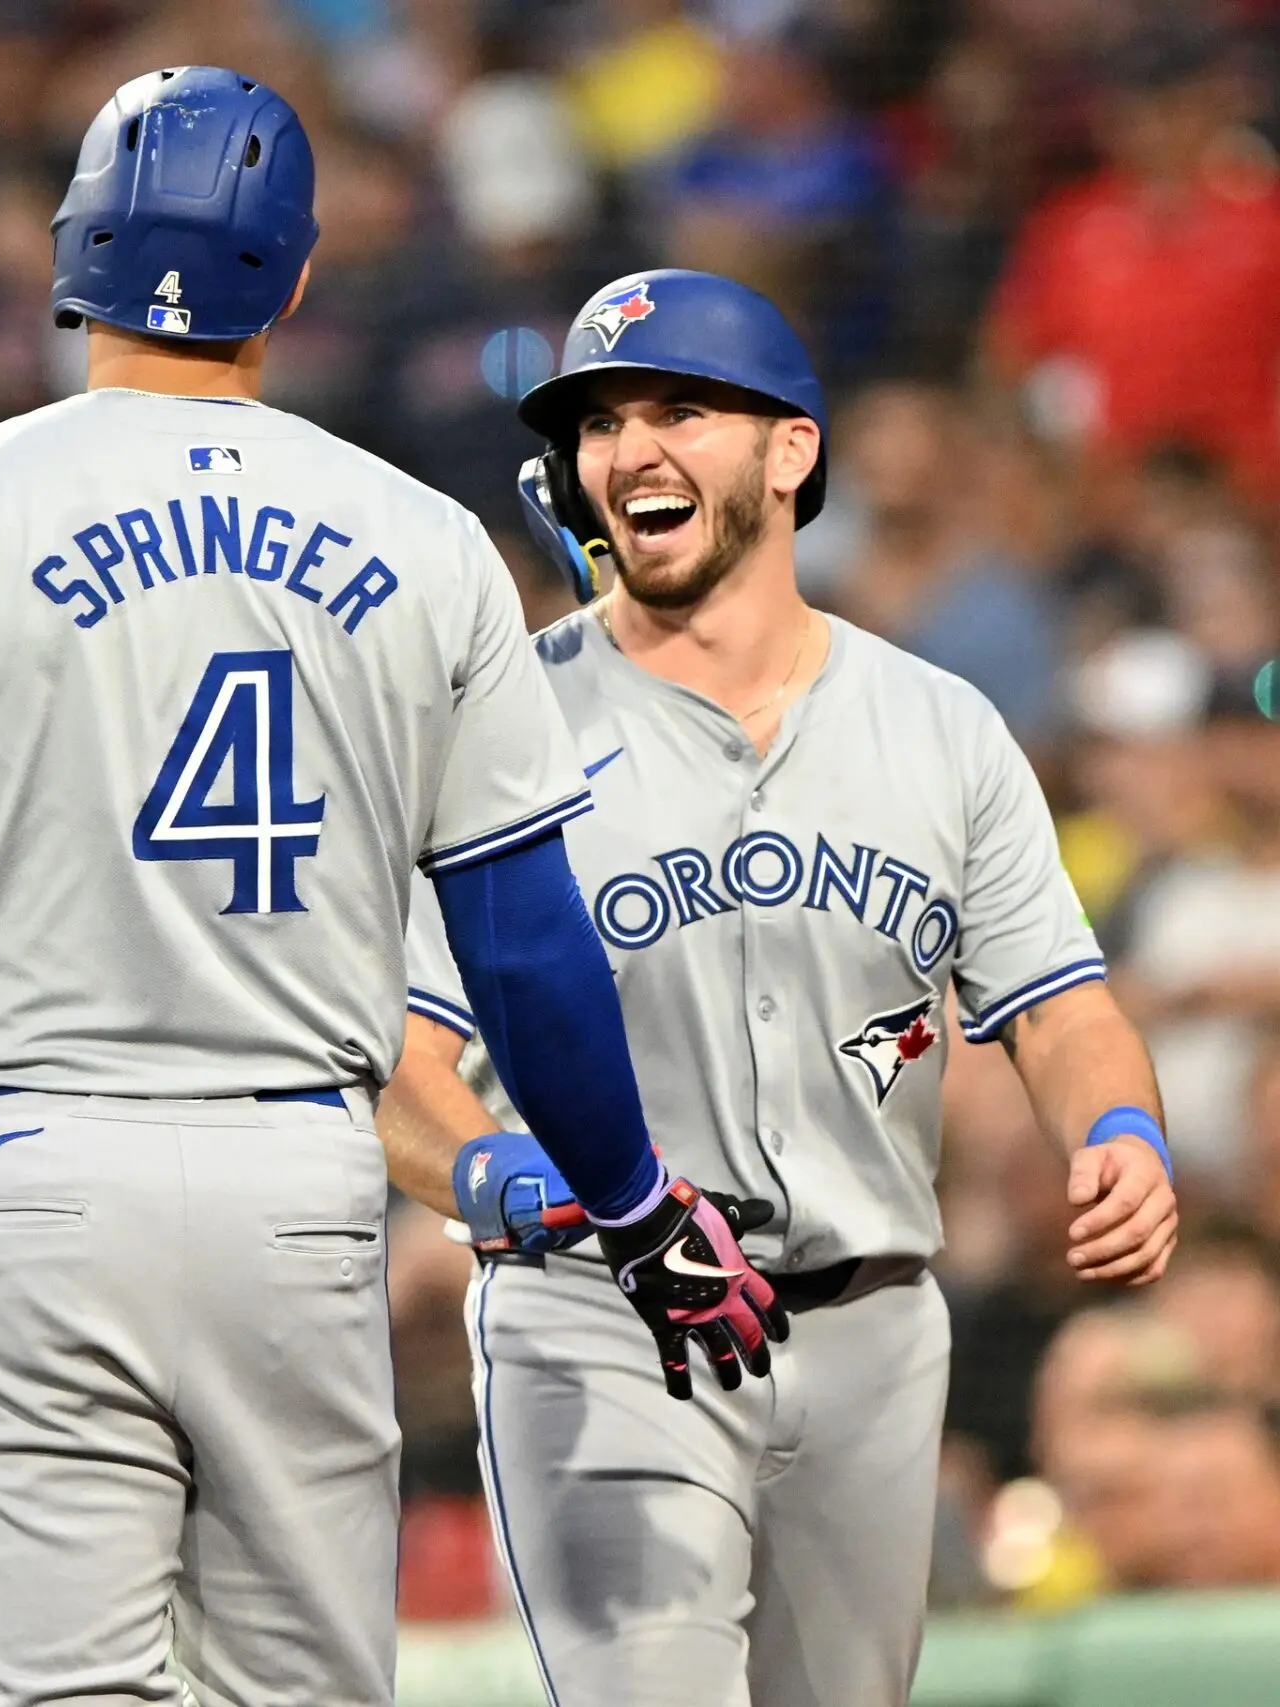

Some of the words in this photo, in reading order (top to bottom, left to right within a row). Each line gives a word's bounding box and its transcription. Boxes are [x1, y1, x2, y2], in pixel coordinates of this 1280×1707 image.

[154, 270, 182, 304] 4
[32, 495, 399, 636] SPRINGER
[132, 649, 326, 915] 4
[593, 830, 959, 975] ORONTO
